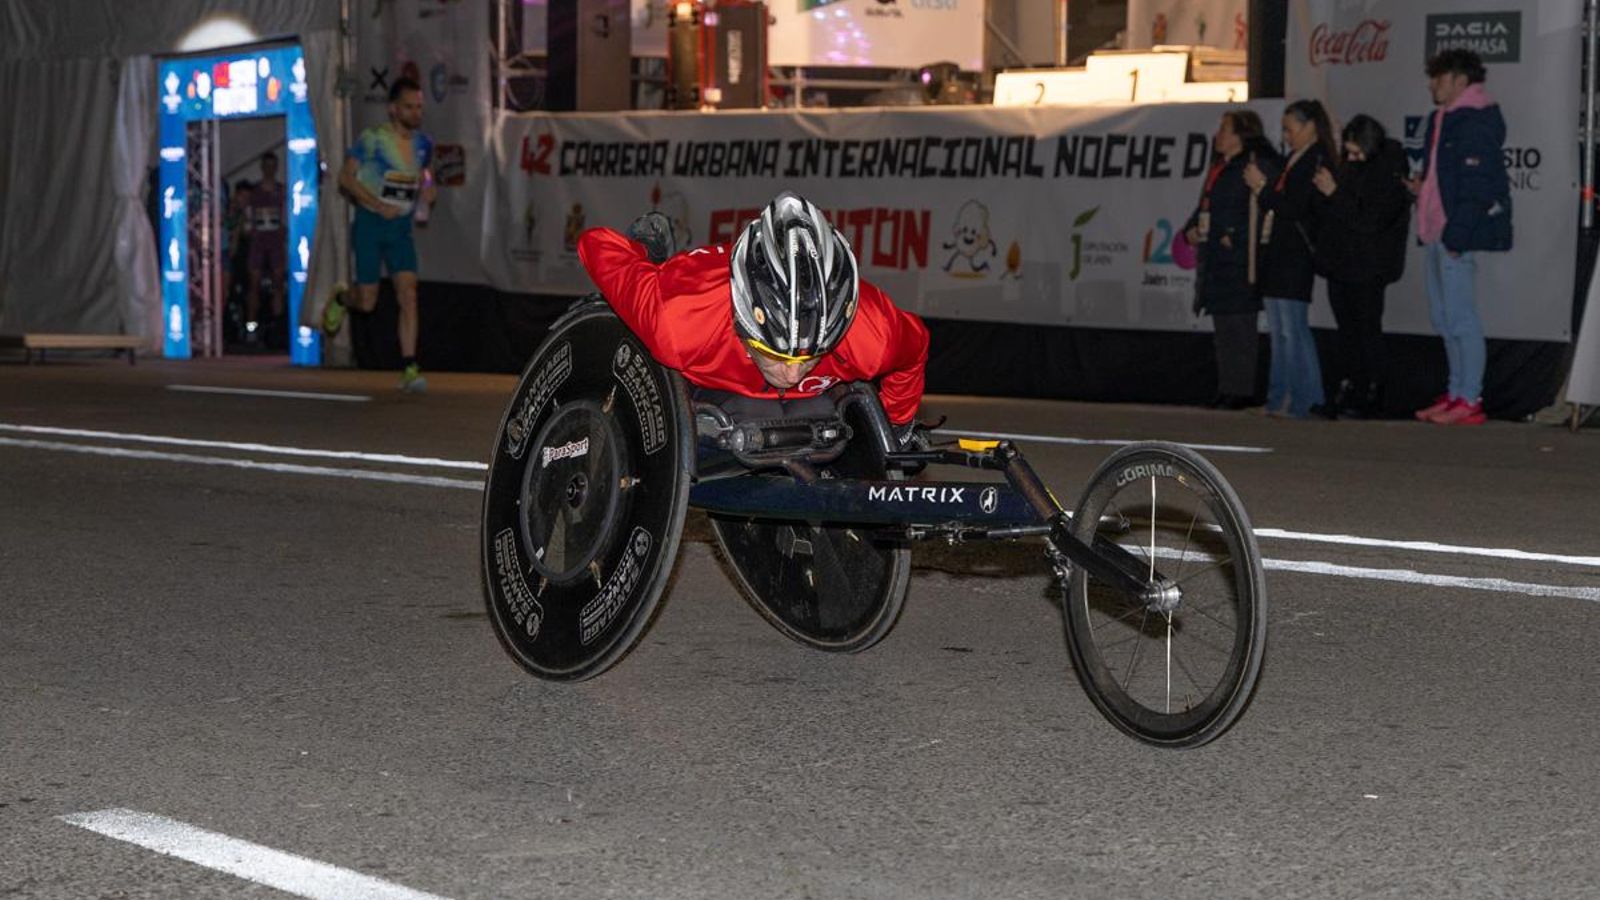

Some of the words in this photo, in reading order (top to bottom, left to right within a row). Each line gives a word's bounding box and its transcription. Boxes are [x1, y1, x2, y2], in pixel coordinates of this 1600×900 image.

[1435, 22, 1507, 36] DACIA
[1034, 82, 1046, 104] 2
[1128, 69, 1140, 102] 1
[520, 134, 555, 174] 42
[559, 139, 669, 176] CARRERA
[673, 138, 781, 176] URBANA
[783, 134, 1044, 178] INTERNACIONAL
[1053, 134, 1176, 179] NOCHE
[1182, 132, 1211, 179] D
[1116, 463, 1176, 487] CORIMA
[868, 485, 965, 504] MATRIX
